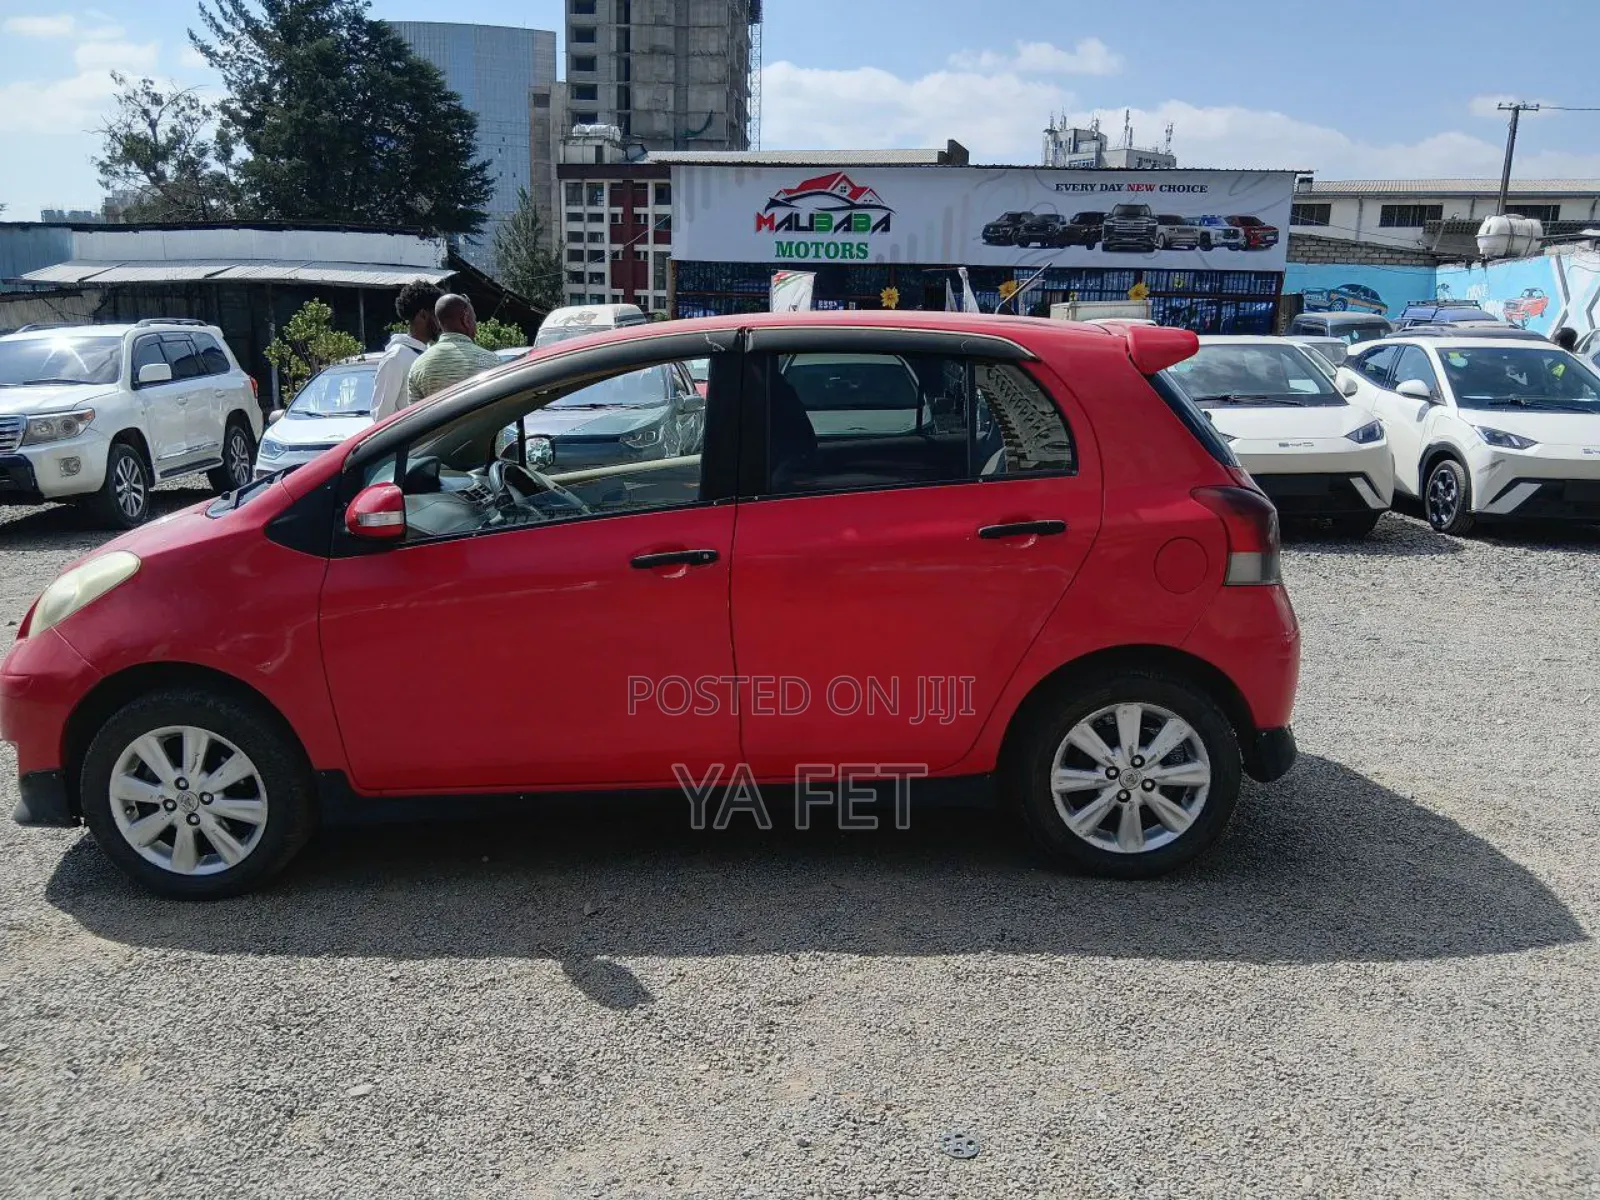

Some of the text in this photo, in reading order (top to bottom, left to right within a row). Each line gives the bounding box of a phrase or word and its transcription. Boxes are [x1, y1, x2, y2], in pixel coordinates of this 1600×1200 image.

[1055, 183, 1209, 193] EVERY DAY NEW CHOICE
[775, 240, 869, 260] MOTORS
